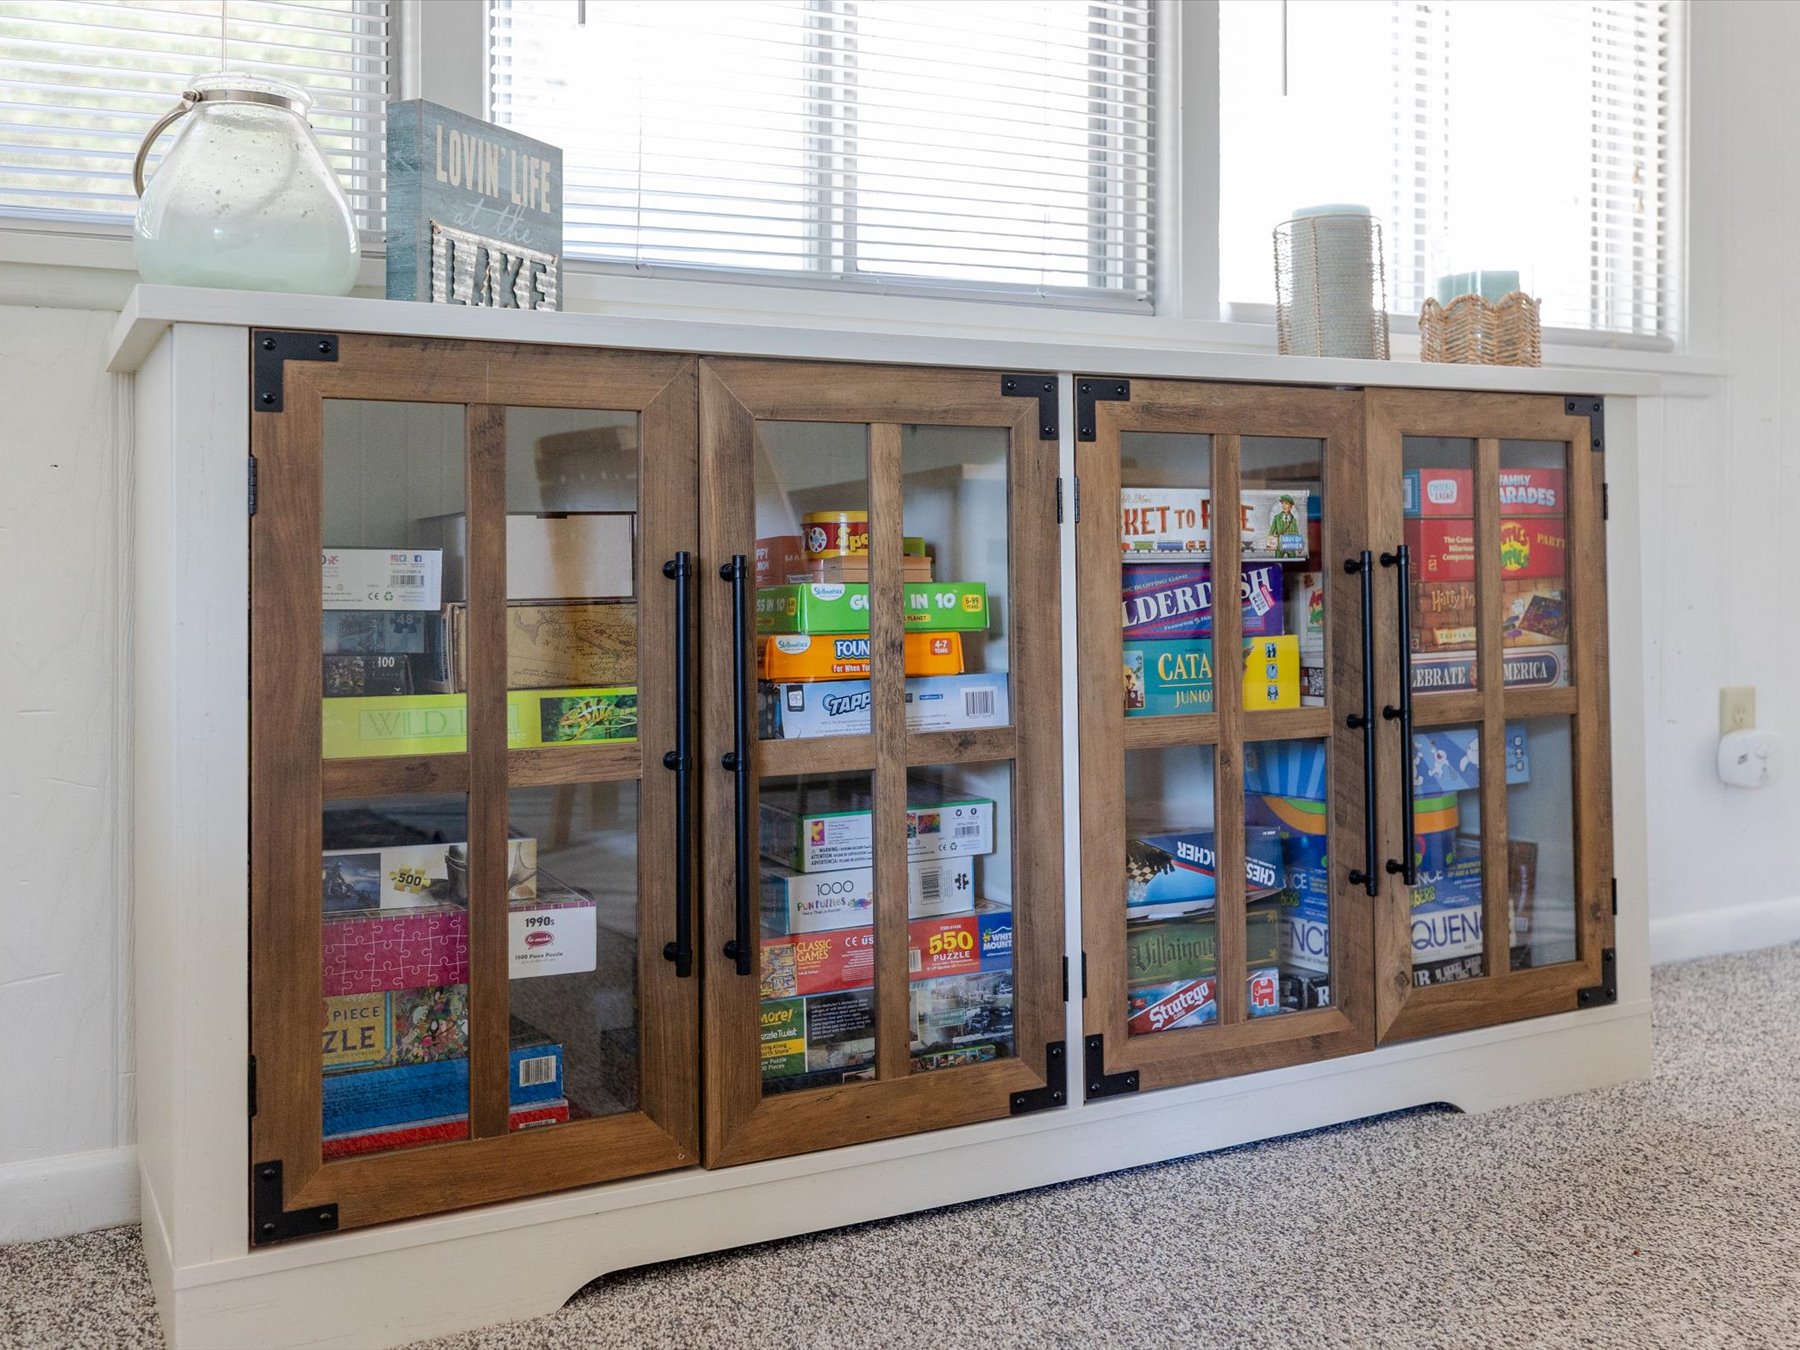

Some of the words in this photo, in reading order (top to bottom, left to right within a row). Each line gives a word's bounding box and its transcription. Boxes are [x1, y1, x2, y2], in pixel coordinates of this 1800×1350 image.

[436, 124, 505, 198] LOVIN'
[511, 149, 551, 214] LIFE
[453, 198, 485, 229] at
[495, 204, 534, 245] the
[440, 231, 551, 310] LAKE
[1500, 474, 1531, 486] FAMILY
[1174, 509, 1195, 529] TO
[910, 593, 929, 610] IN
[935, 593, 957, 609] 10
[1432, 590, 1460, 613] Harry
[1158, 653, 1213, 680] CATA
[368, 711, 447, 736] WILD
[398, 873, 422, 887] 500
[816, 880, 854, 896] 1000
[524, 916, 555, 927] 1990s
[991, 932, 1012, 942] WHIT
[1410, 911, 1484, 950] QUEN
[797, 939, 832, 952] CLASSIC
[929, 931, 974, 955] 550
[983, 941, 1012, 950] MOUNT
[797, 950, 829, 962] GAMES
[933, 951, 971, 962] PUZZLE
[333, 1006, 381, 1022] PIECE
[1149, 982, 1209, 1030] Stratego
